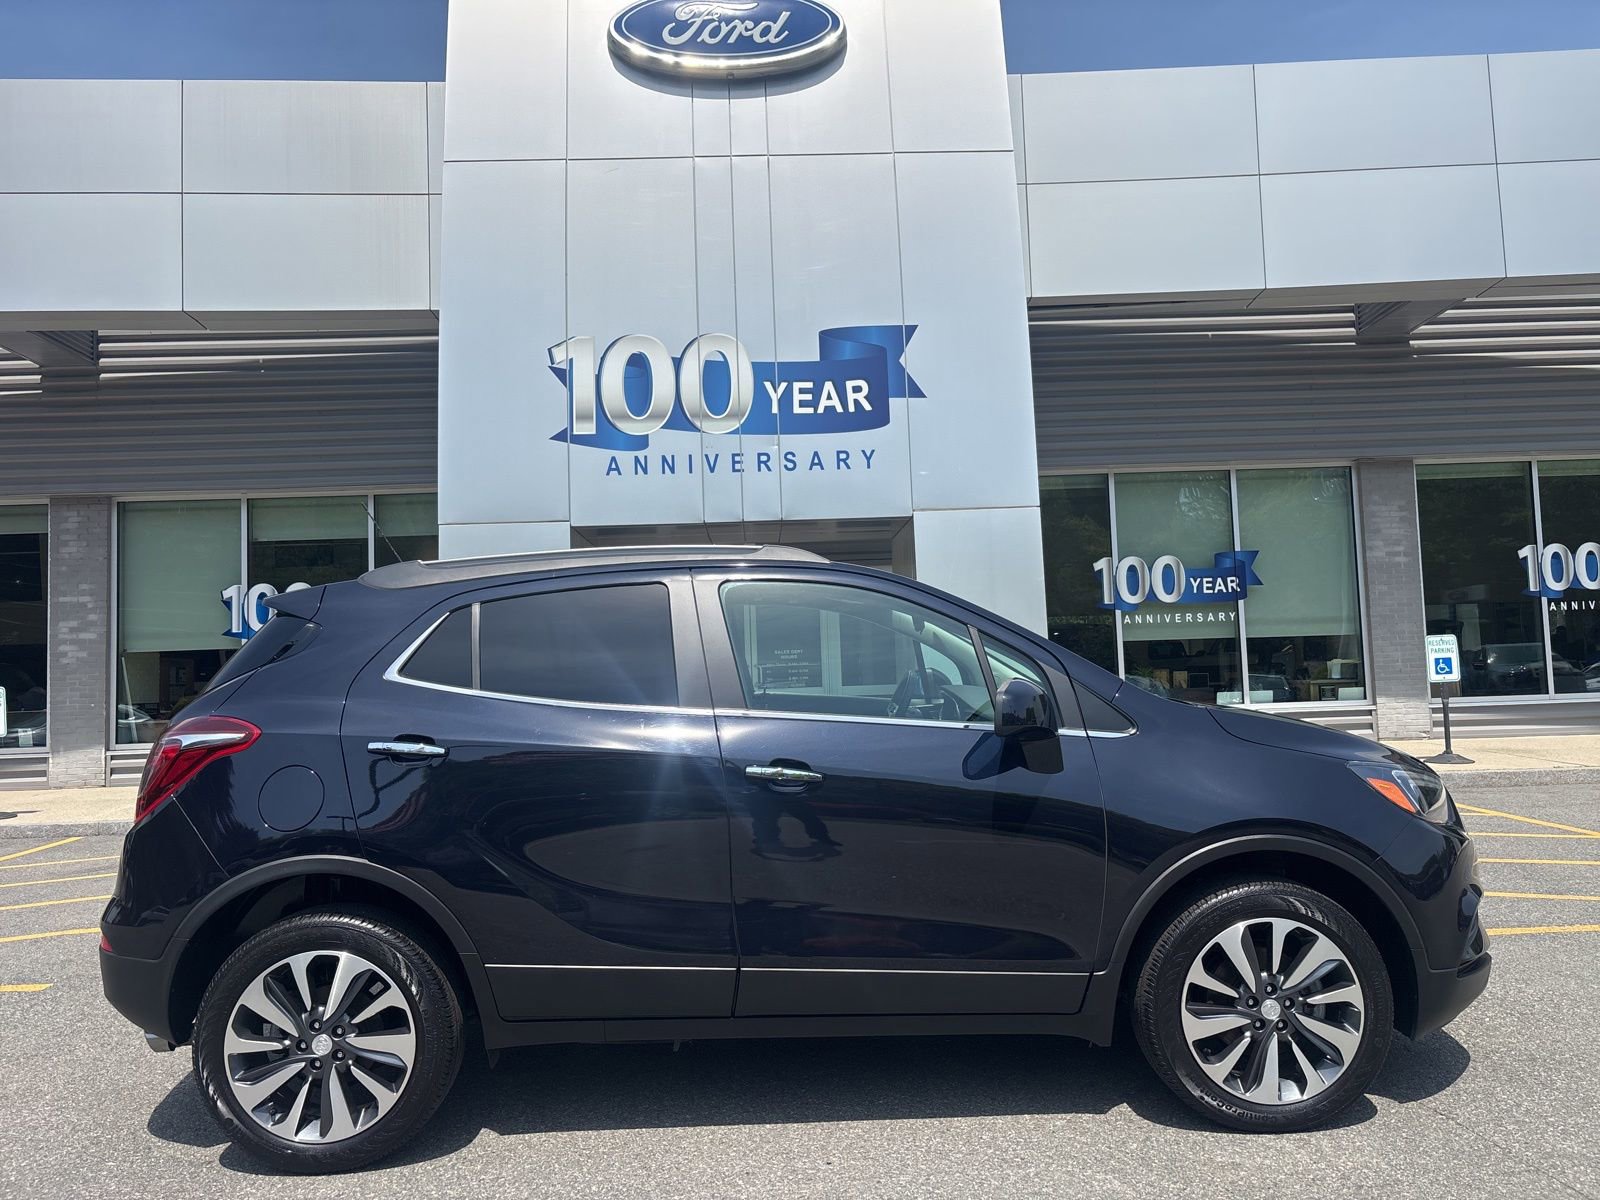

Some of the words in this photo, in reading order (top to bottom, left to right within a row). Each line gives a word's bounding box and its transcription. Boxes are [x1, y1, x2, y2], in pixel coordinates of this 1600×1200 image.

[662, 1, 791, 45] Ford
[547, 333, 754, 435] 100
[763, 379, 873, 414] YEAR
[605, 449, 876, 476] ANNIVERSARY
[1093, 555, 1186, 605] 100
[1190, 576, 1240, 594] YEAR
[1517, 541, 1600, 592] 100
[221, 582, 312, 633] 10
[1124, 612, 1236, 625] ANNIVERSARY
